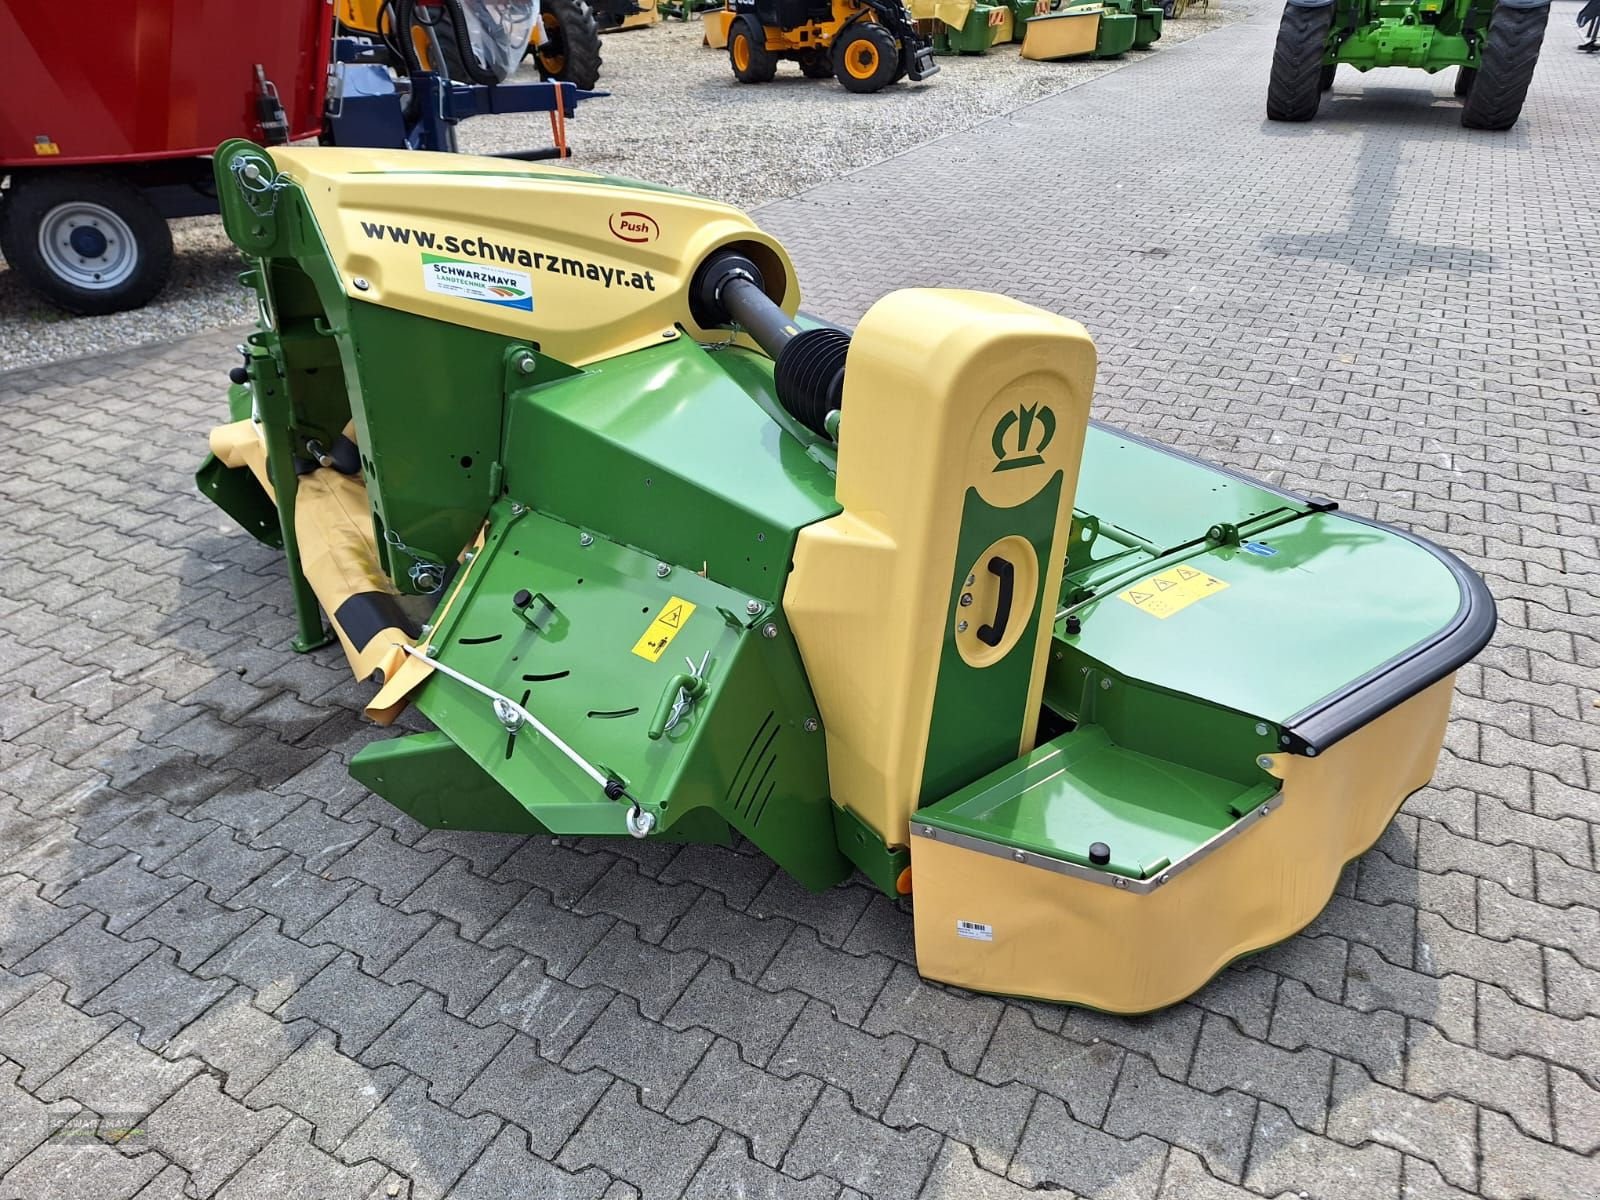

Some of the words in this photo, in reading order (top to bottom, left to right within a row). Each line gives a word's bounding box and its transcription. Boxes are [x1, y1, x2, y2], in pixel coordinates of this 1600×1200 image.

[620, 220, 649, 233] Push
[361, 221, 656, 291] www.schwarzmayr.at
[433, 264, 517, 287] SCHWARZMAYR
[436, 274, 486, 288] LANDTECHNIK
